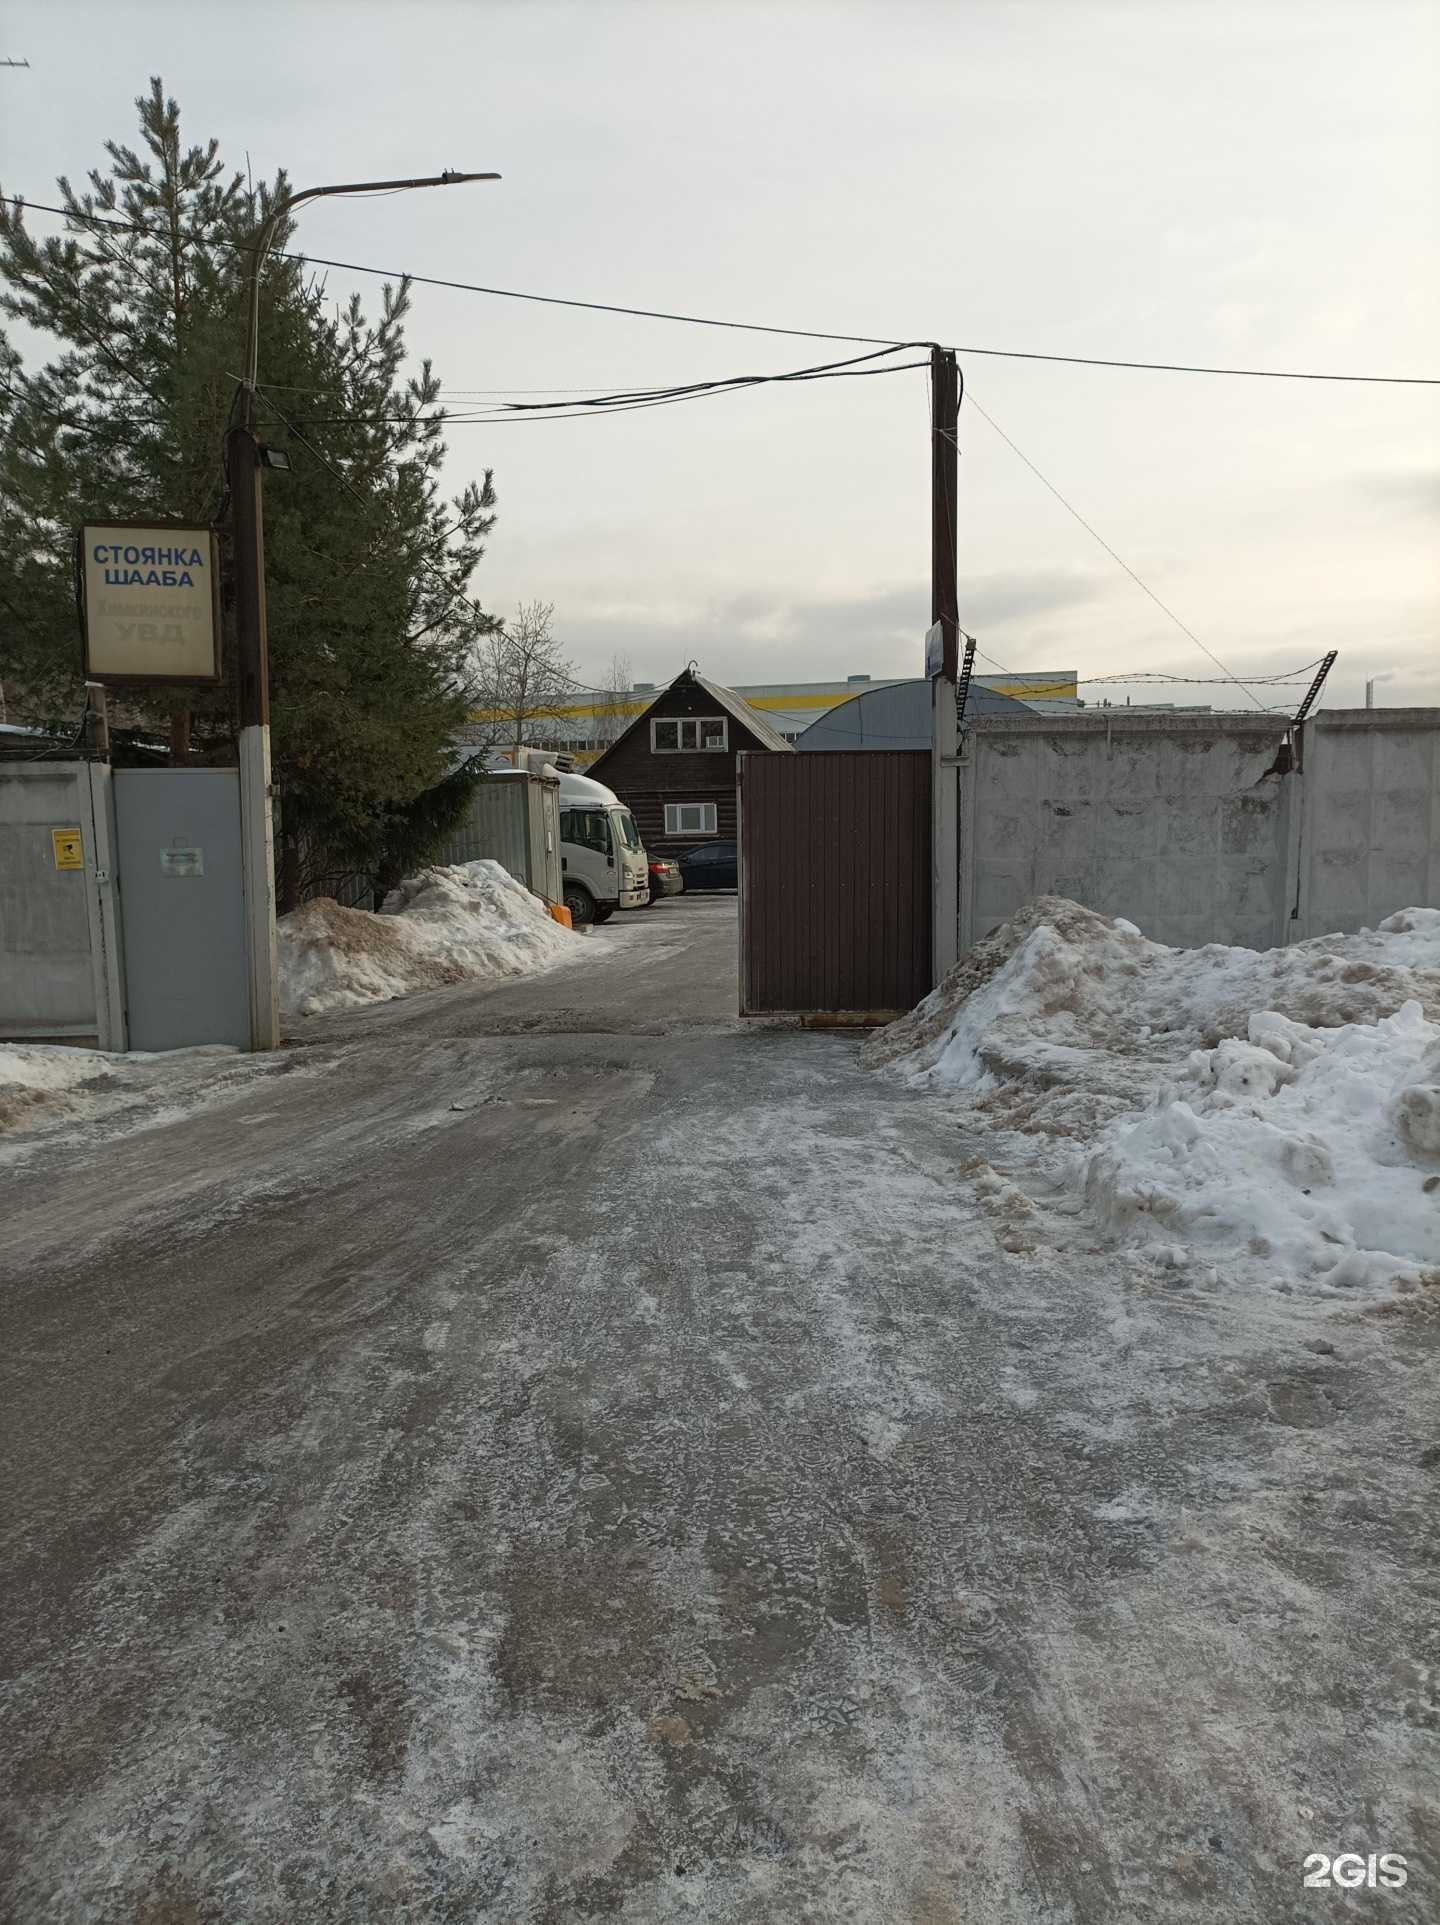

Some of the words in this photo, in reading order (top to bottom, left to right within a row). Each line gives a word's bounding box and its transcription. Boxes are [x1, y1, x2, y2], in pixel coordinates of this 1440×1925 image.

[93, 545, 203, 567] СТОЯНКА
[104, 569, 194, 587] ШААБА
[114, 623, 185, 645] УВД
